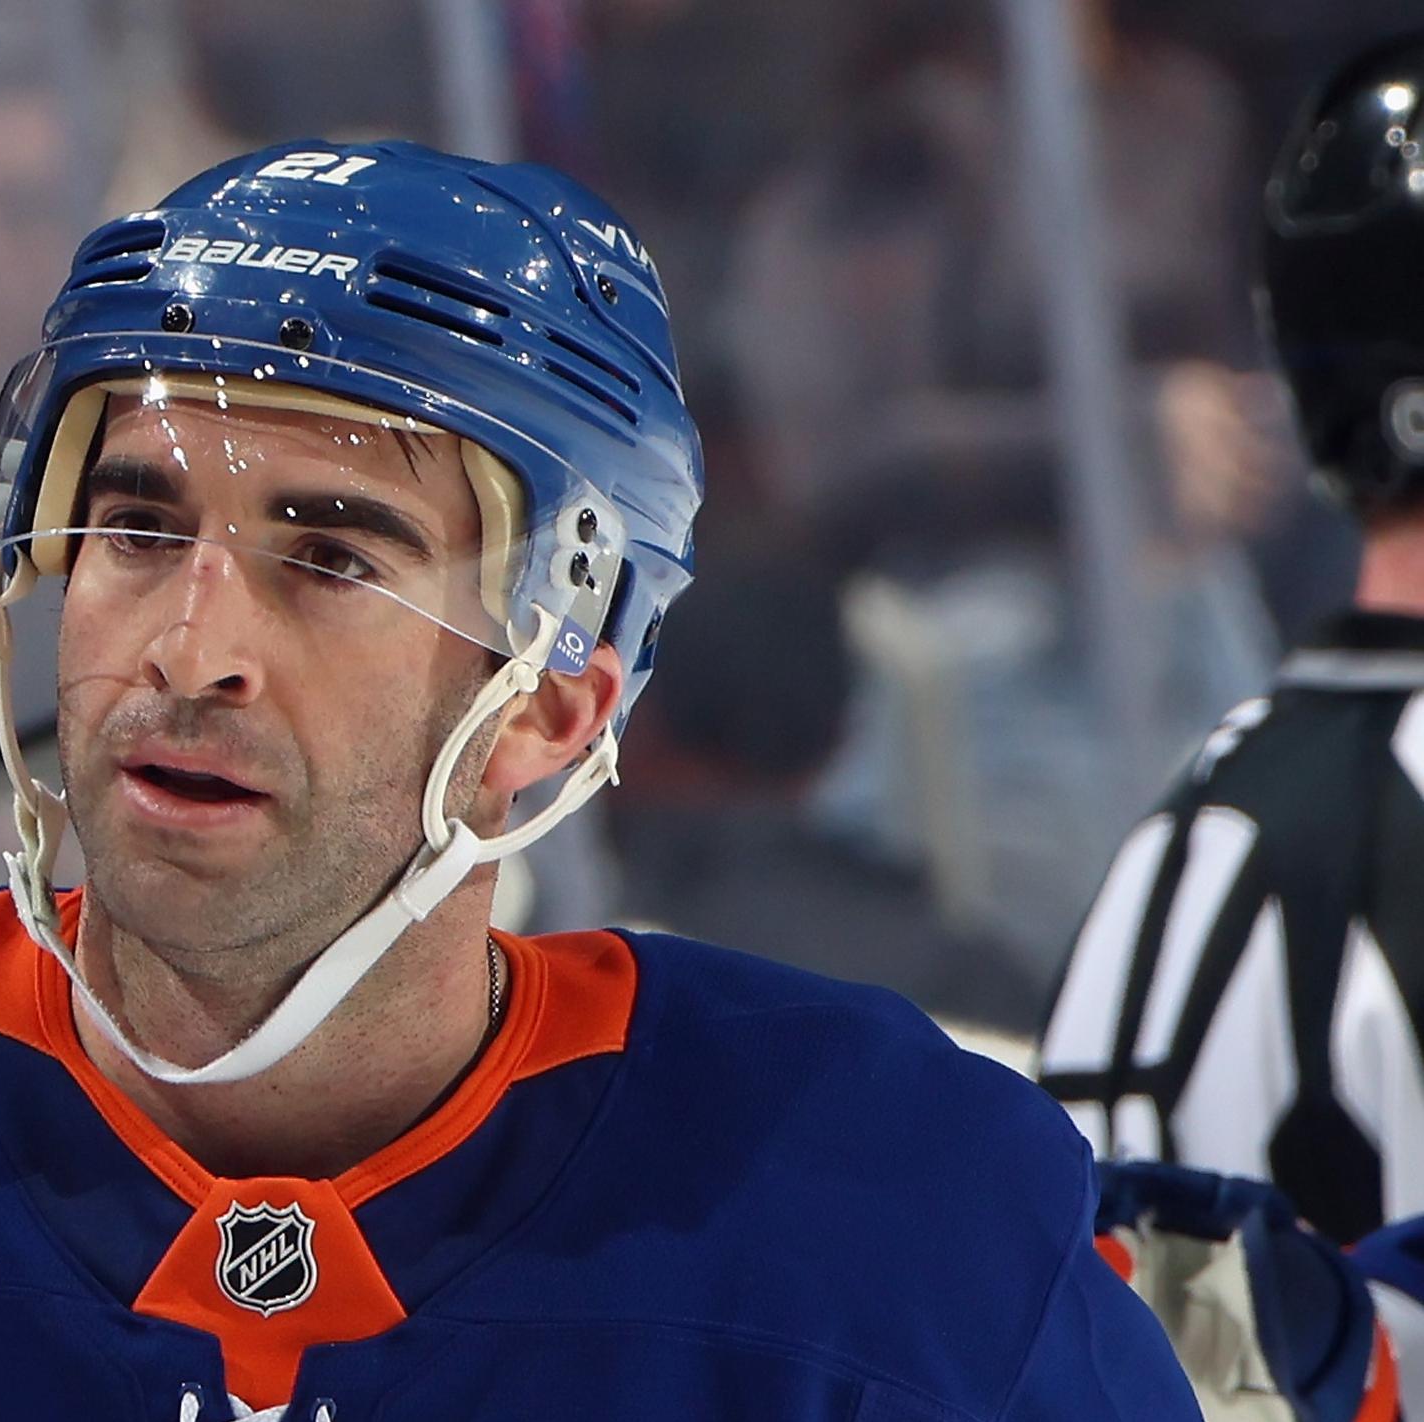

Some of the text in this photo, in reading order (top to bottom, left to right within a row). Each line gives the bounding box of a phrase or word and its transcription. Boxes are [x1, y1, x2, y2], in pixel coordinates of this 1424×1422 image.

[254, 150, 377, 187] 21
[161, 234, 360, 282] BAUER
[237, 1232, 296, 1291] NHL
